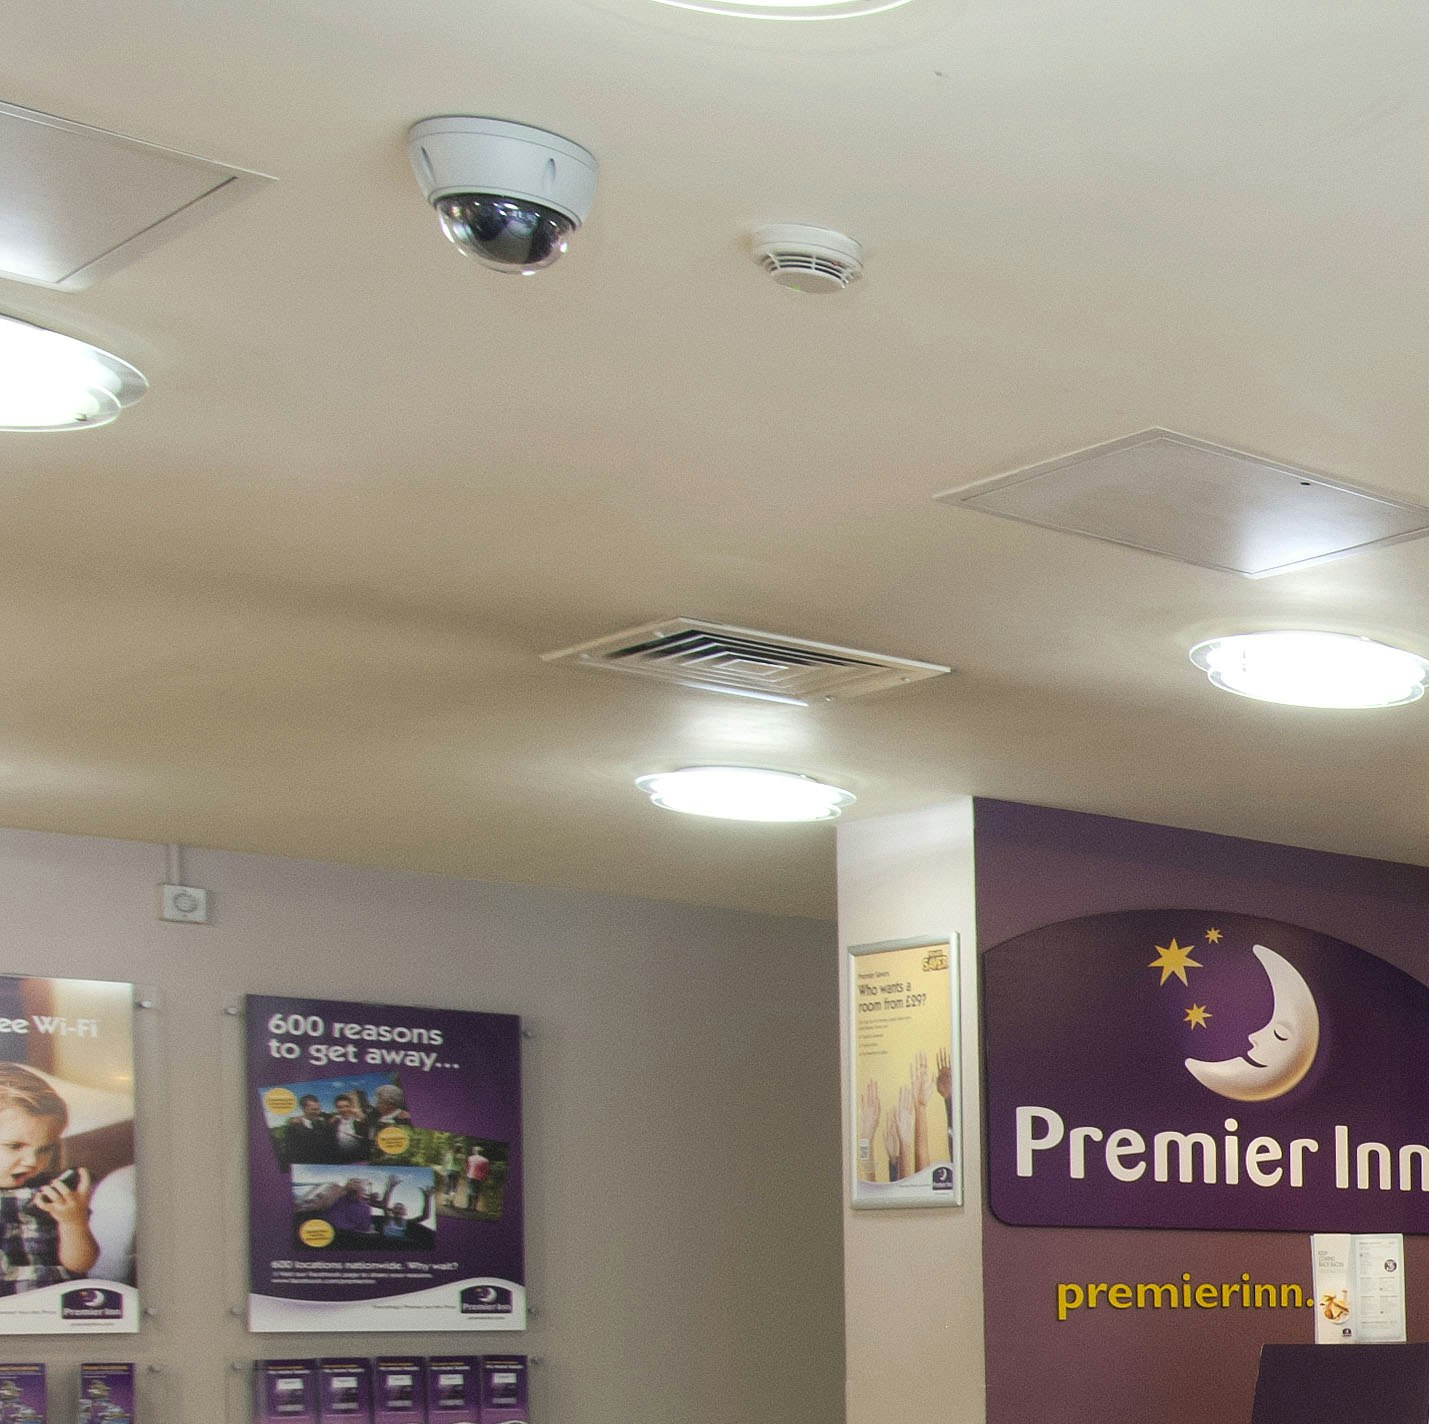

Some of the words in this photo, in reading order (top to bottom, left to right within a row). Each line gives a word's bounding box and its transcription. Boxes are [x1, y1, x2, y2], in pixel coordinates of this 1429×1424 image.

[858, 984, 878, 996] Who
[880, 982, 904, 994] wants
[858, 1001, 881, 1013] room
[884, 998, 904, 1011] from
[32, 1015, 98, 1038] Wi-Fi
[267, 1013, 325, 1037] 600
[332, 1021, 444, 1046] reasons
[268, 1038, 301, 1060] to
[309, 1043, 358, 1066] get
[364, 1048, 461, 1072] away...
[1015, 1106, 1319, 1188] Premier
